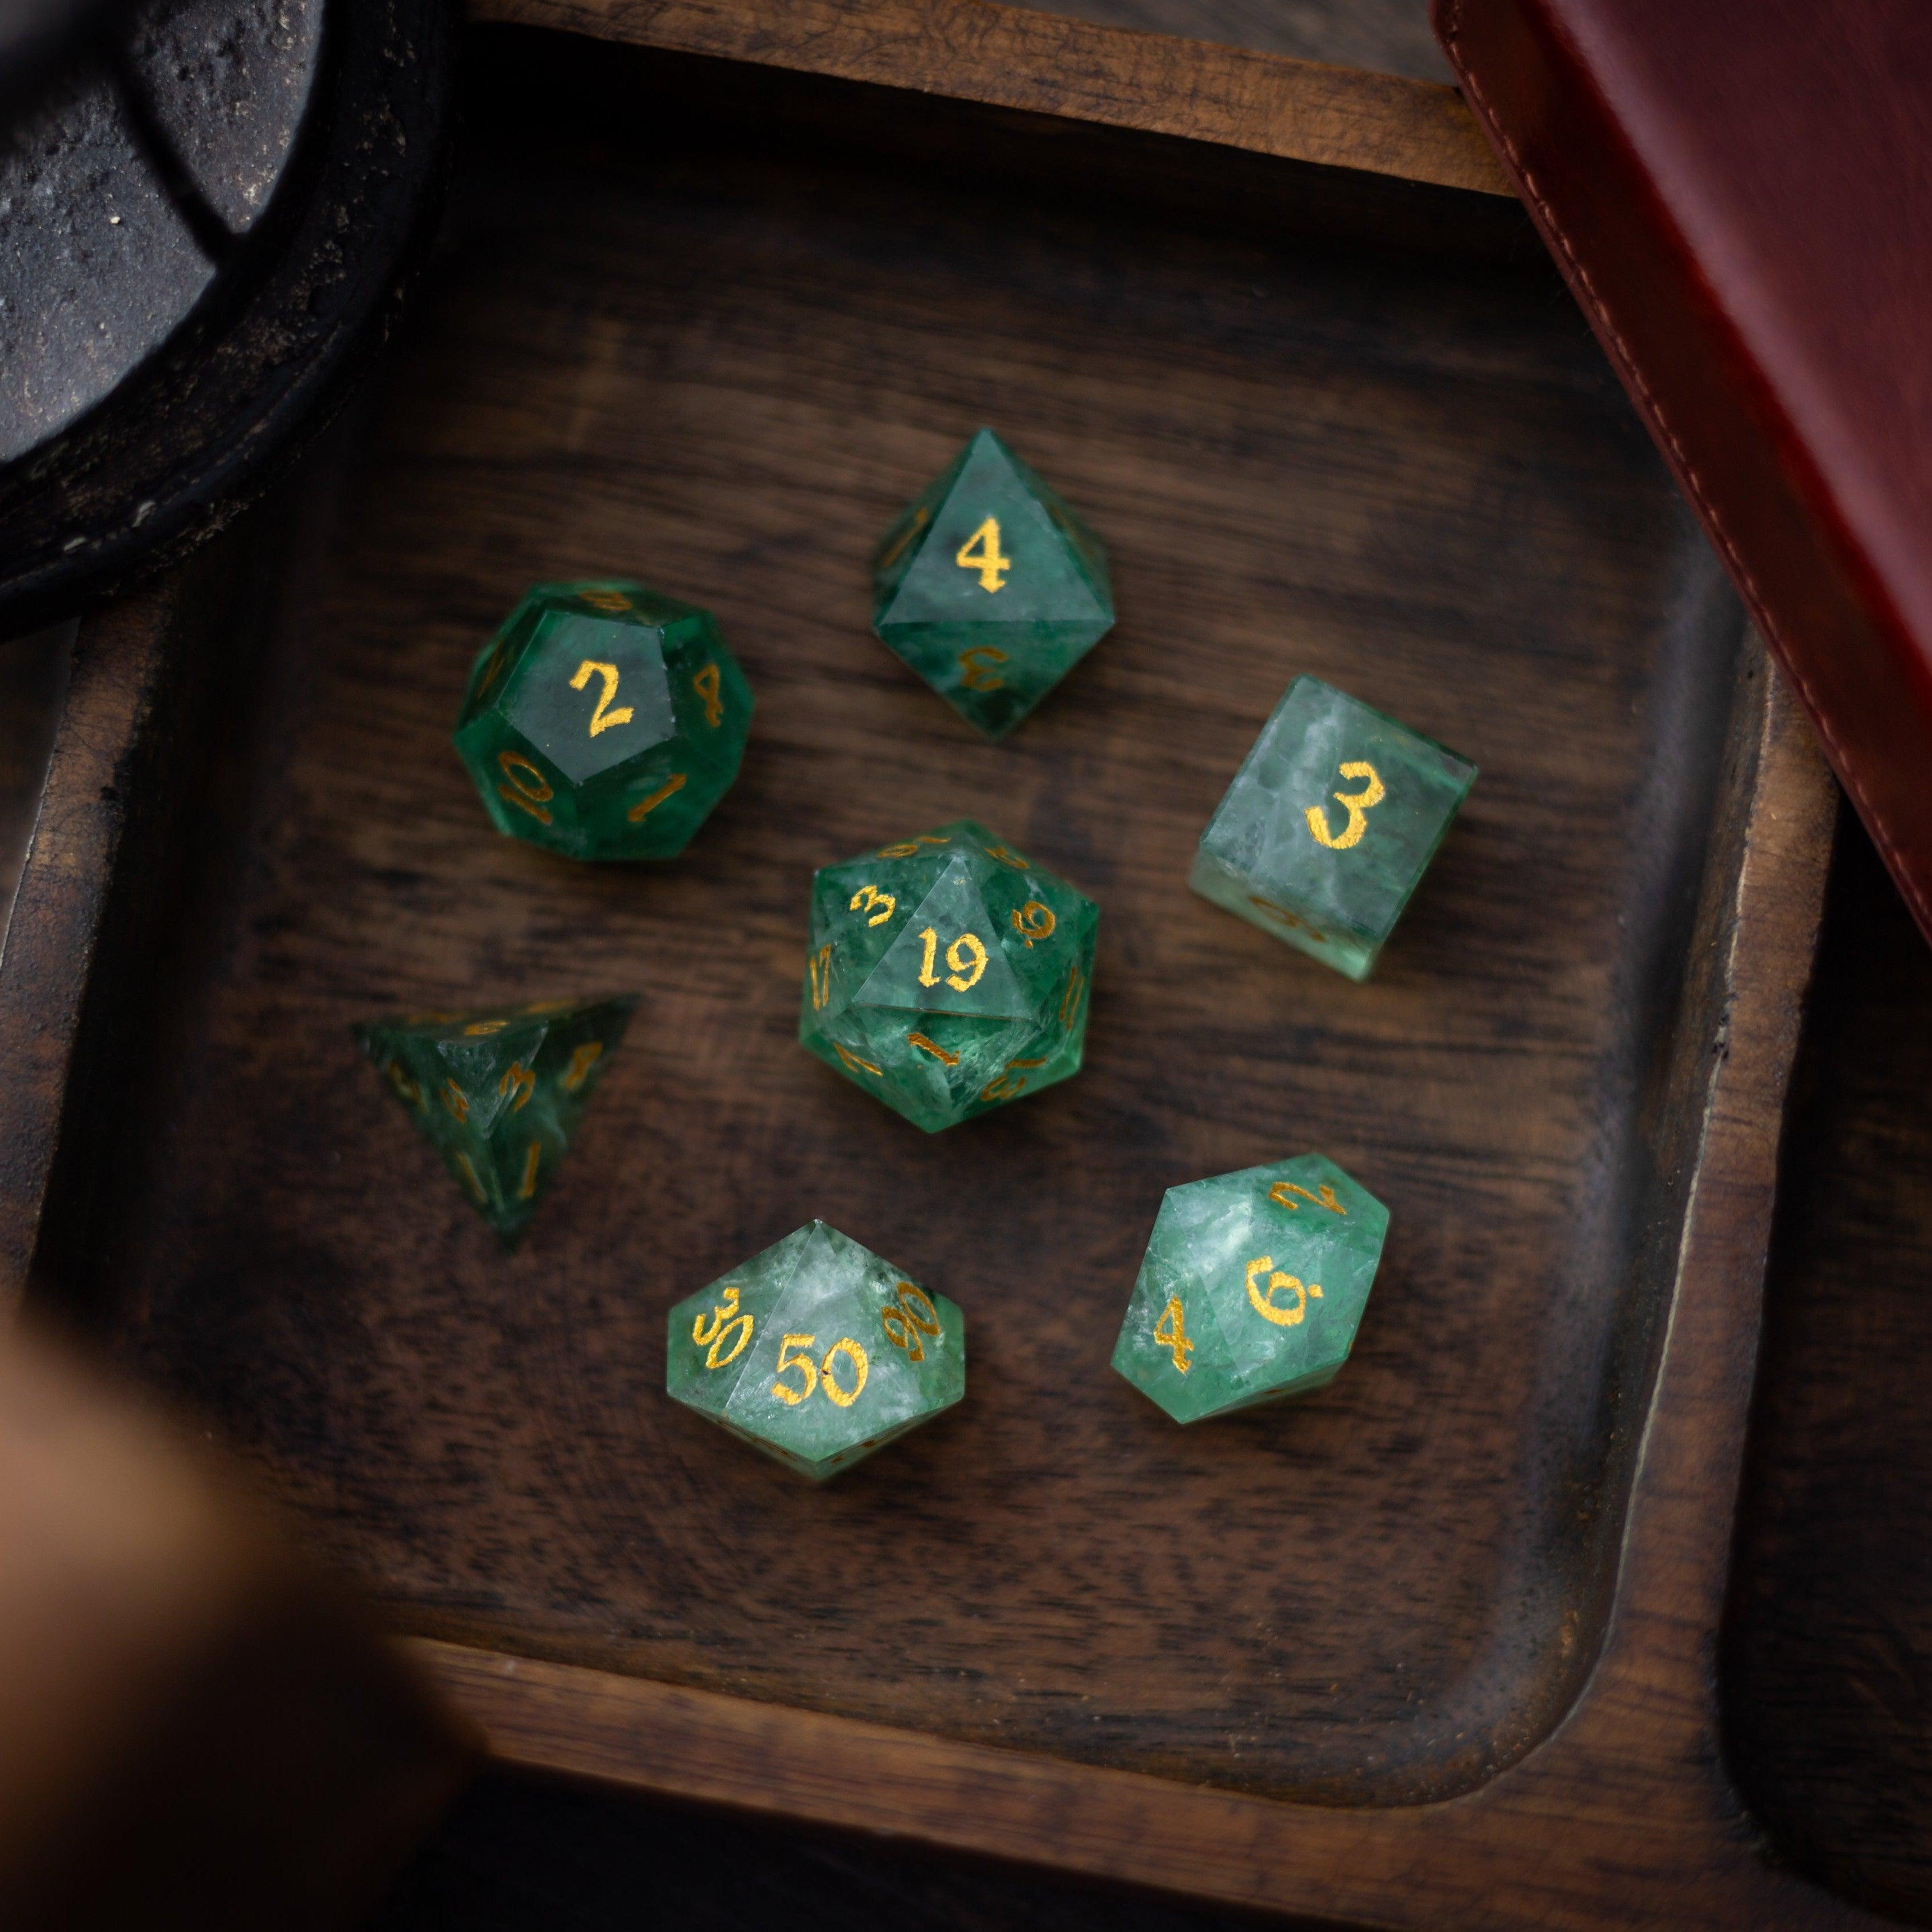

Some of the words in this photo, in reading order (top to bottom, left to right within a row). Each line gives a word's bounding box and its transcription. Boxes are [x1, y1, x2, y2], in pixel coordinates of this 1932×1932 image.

[957, 519, 1009, 592] 4
[570, 660, 633, 736] 2
[694, 665, 722, 726] 4
[959, 647, 1007, 690] 3
[499, 752, 553, 823] 10
[629, 774, 686, 822] 1
[1305, 762, 1384, 849] 3
[850, 885, 895, 927] 3
[919, 927, 988, 992] 19
[908, 1033, 959, 1066] 1
[1269, 1182, 1345, 1214] 2
[692, 1288, 753, 1368] 30
[881, 1282, 940, 1361] 90
[1154, 1297, 1193, 1373] 4
[771, 1334, 868, 1407] 50
